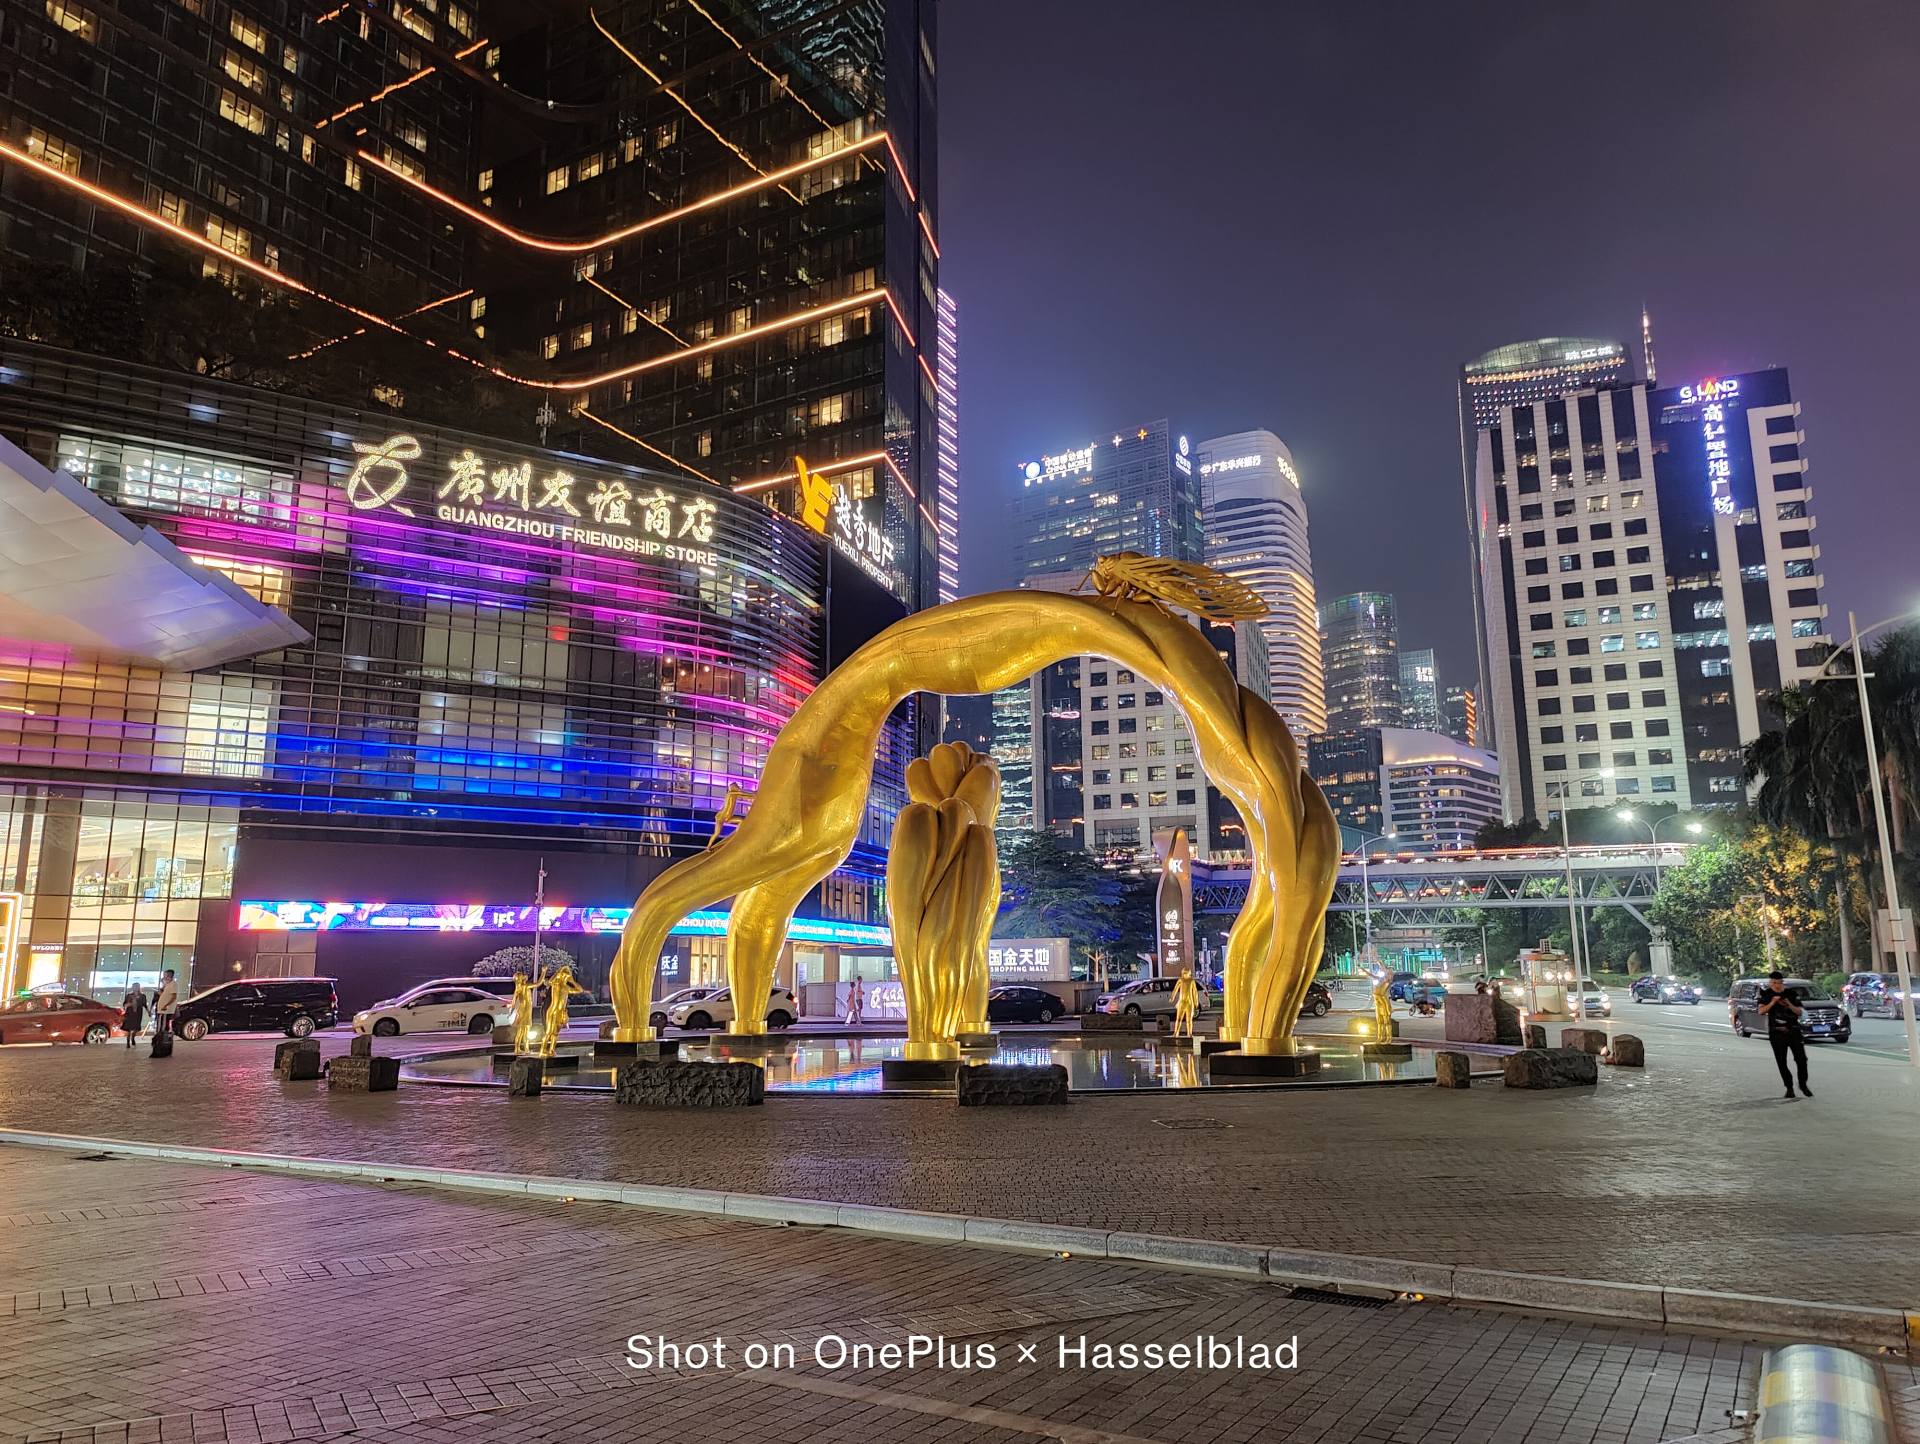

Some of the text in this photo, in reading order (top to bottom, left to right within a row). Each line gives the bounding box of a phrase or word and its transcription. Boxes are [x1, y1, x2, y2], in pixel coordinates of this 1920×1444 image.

[438, 505, 718, 566] GUANGZHOU FRIENDSHIP STORE
[834, 484, 894, 567] 越秀地产
[833, 532, 894, 591] YUEXIU PROPERTY
[493, 911, 515, 928] IFC
[989, 947, 1050, 966] 国金天地
[452, 1011, 467, 1019] ON
